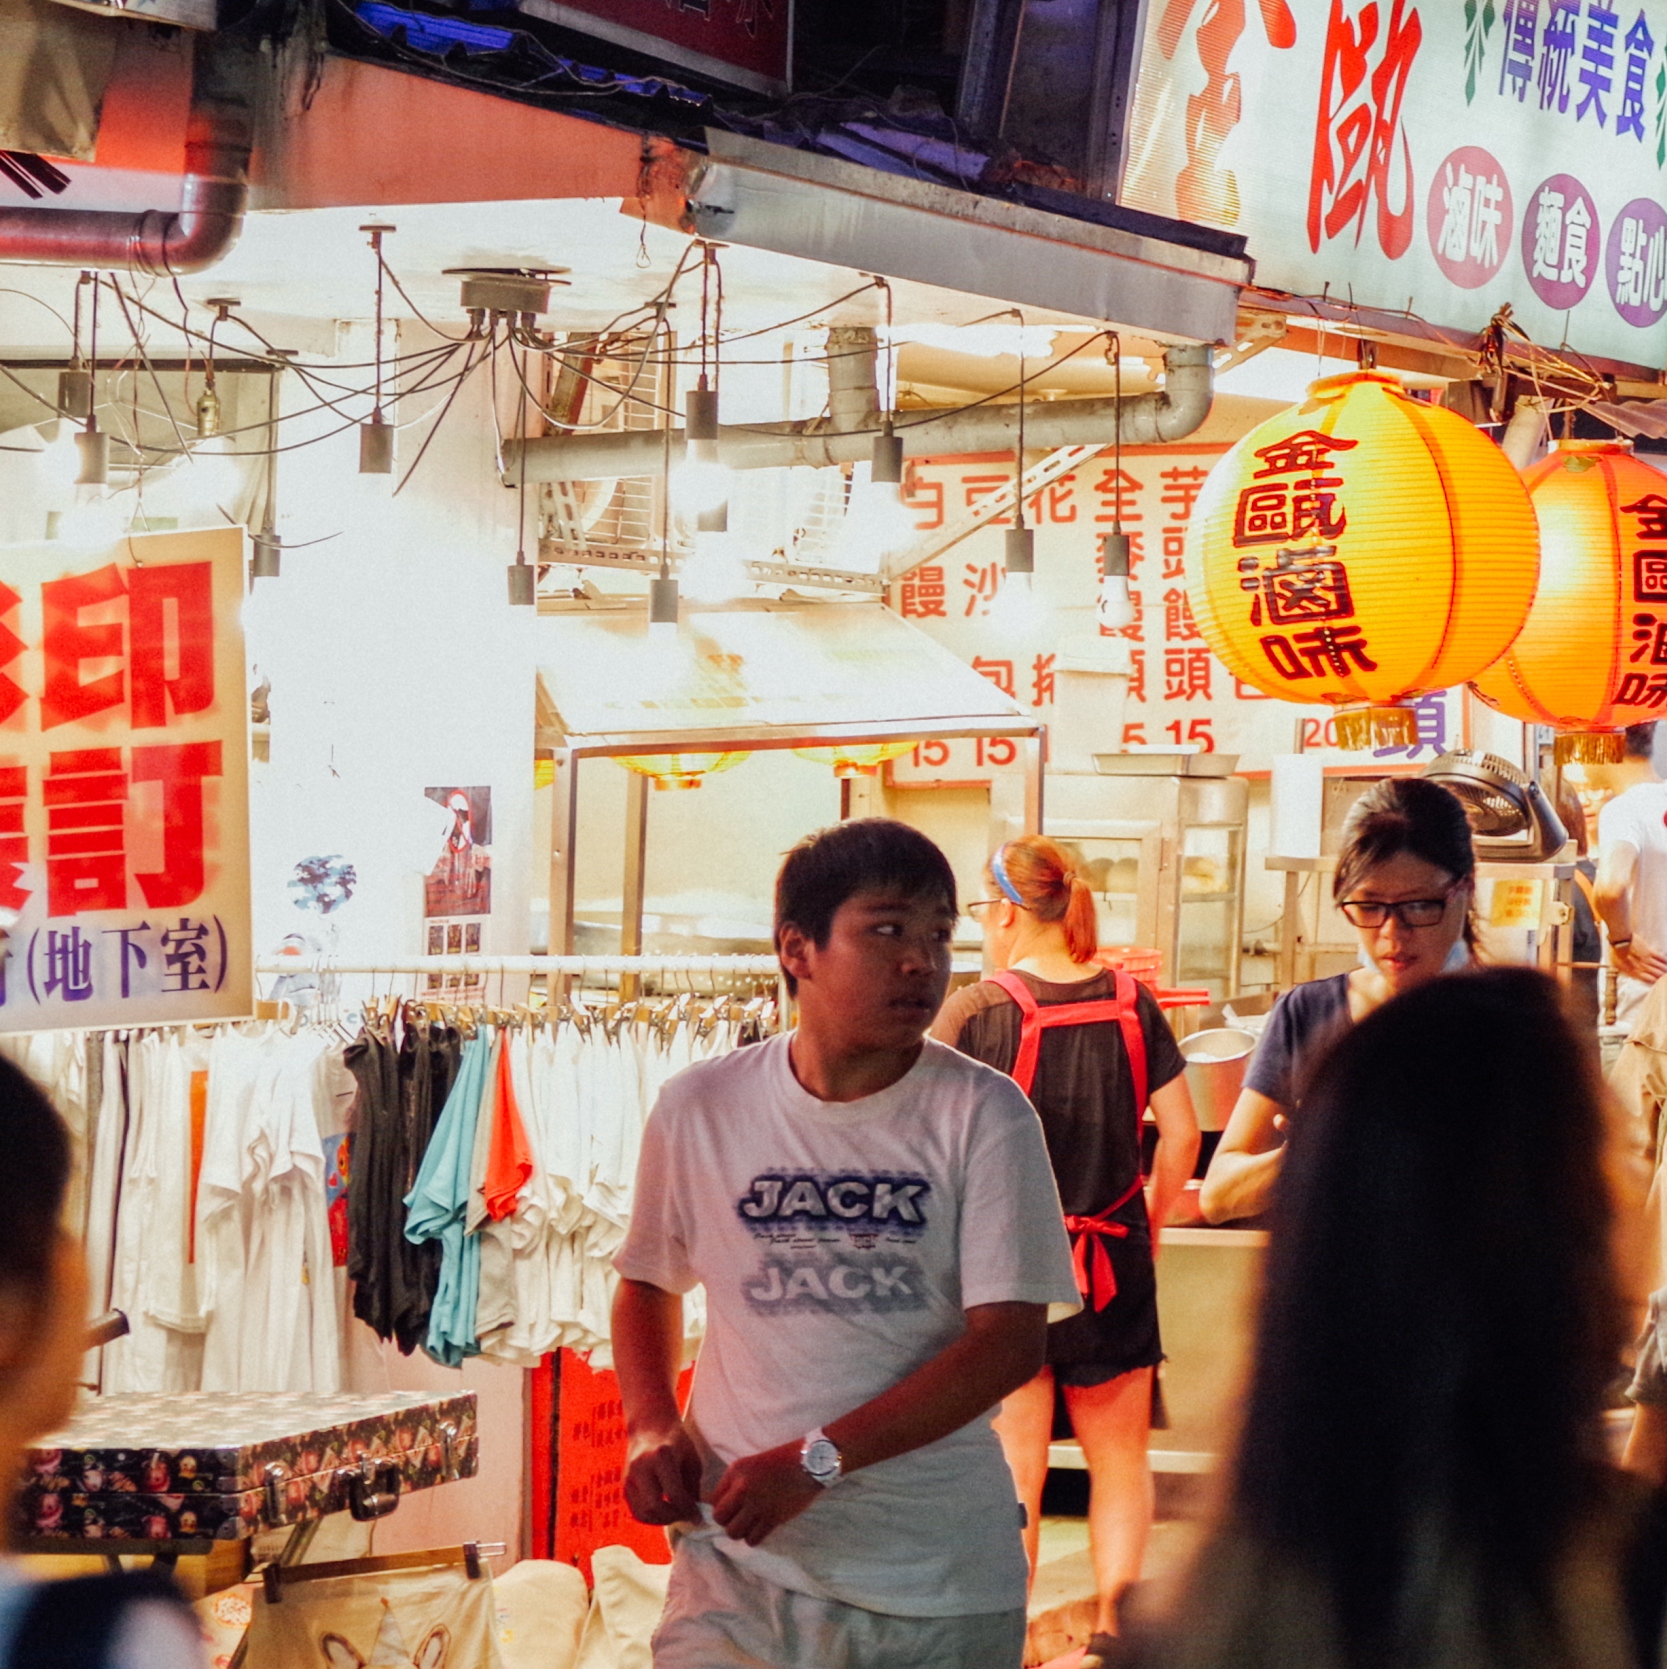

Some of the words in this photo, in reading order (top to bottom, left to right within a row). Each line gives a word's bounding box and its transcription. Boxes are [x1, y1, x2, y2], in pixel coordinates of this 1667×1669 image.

[1437, 169, 1504, 270] 滷味
[1530, 186, 1593, 286] 麵食
[1232, 430, 1377, 680] 金甌滷味
[975, 737, 1017, 766] 15
[0, 914, 227, 1004] (地下室)
[738, 1173, 931, 1225] JACK
[749, 1264, 924, 1303] JACK
